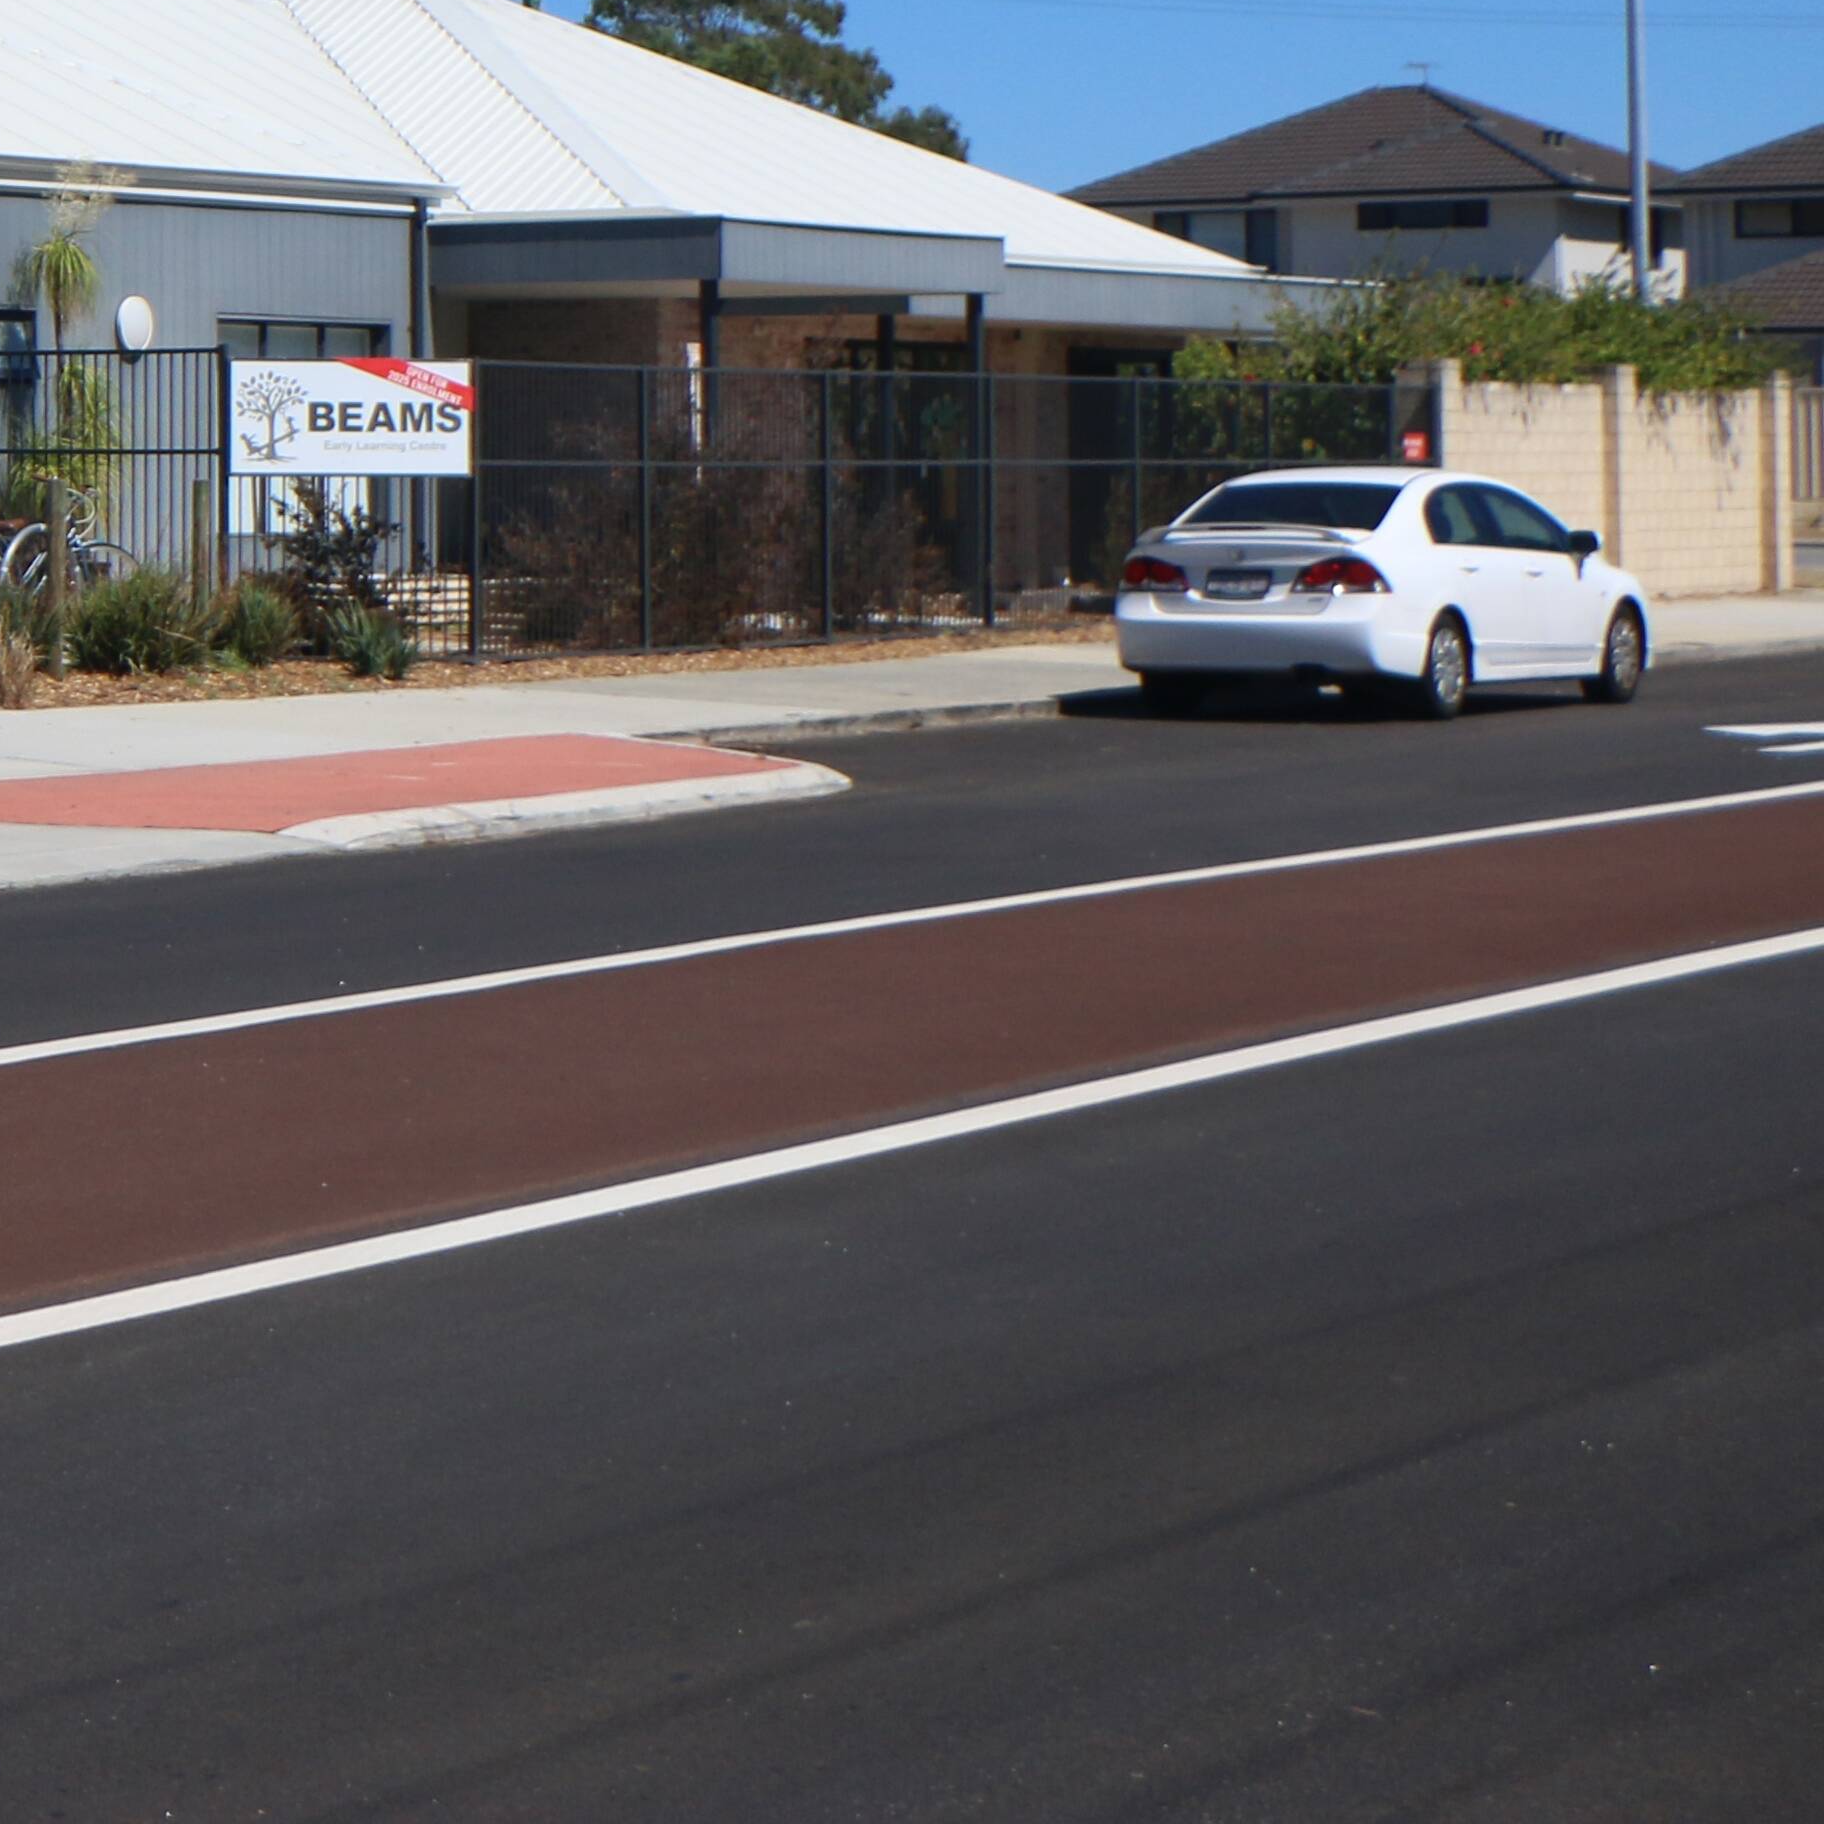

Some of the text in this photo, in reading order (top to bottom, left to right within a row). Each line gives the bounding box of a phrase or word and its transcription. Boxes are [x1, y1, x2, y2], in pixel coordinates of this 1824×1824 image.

[308, 401, 462, 433] BEAMS
[323, 439, 447, 453] Early Learning Centre
